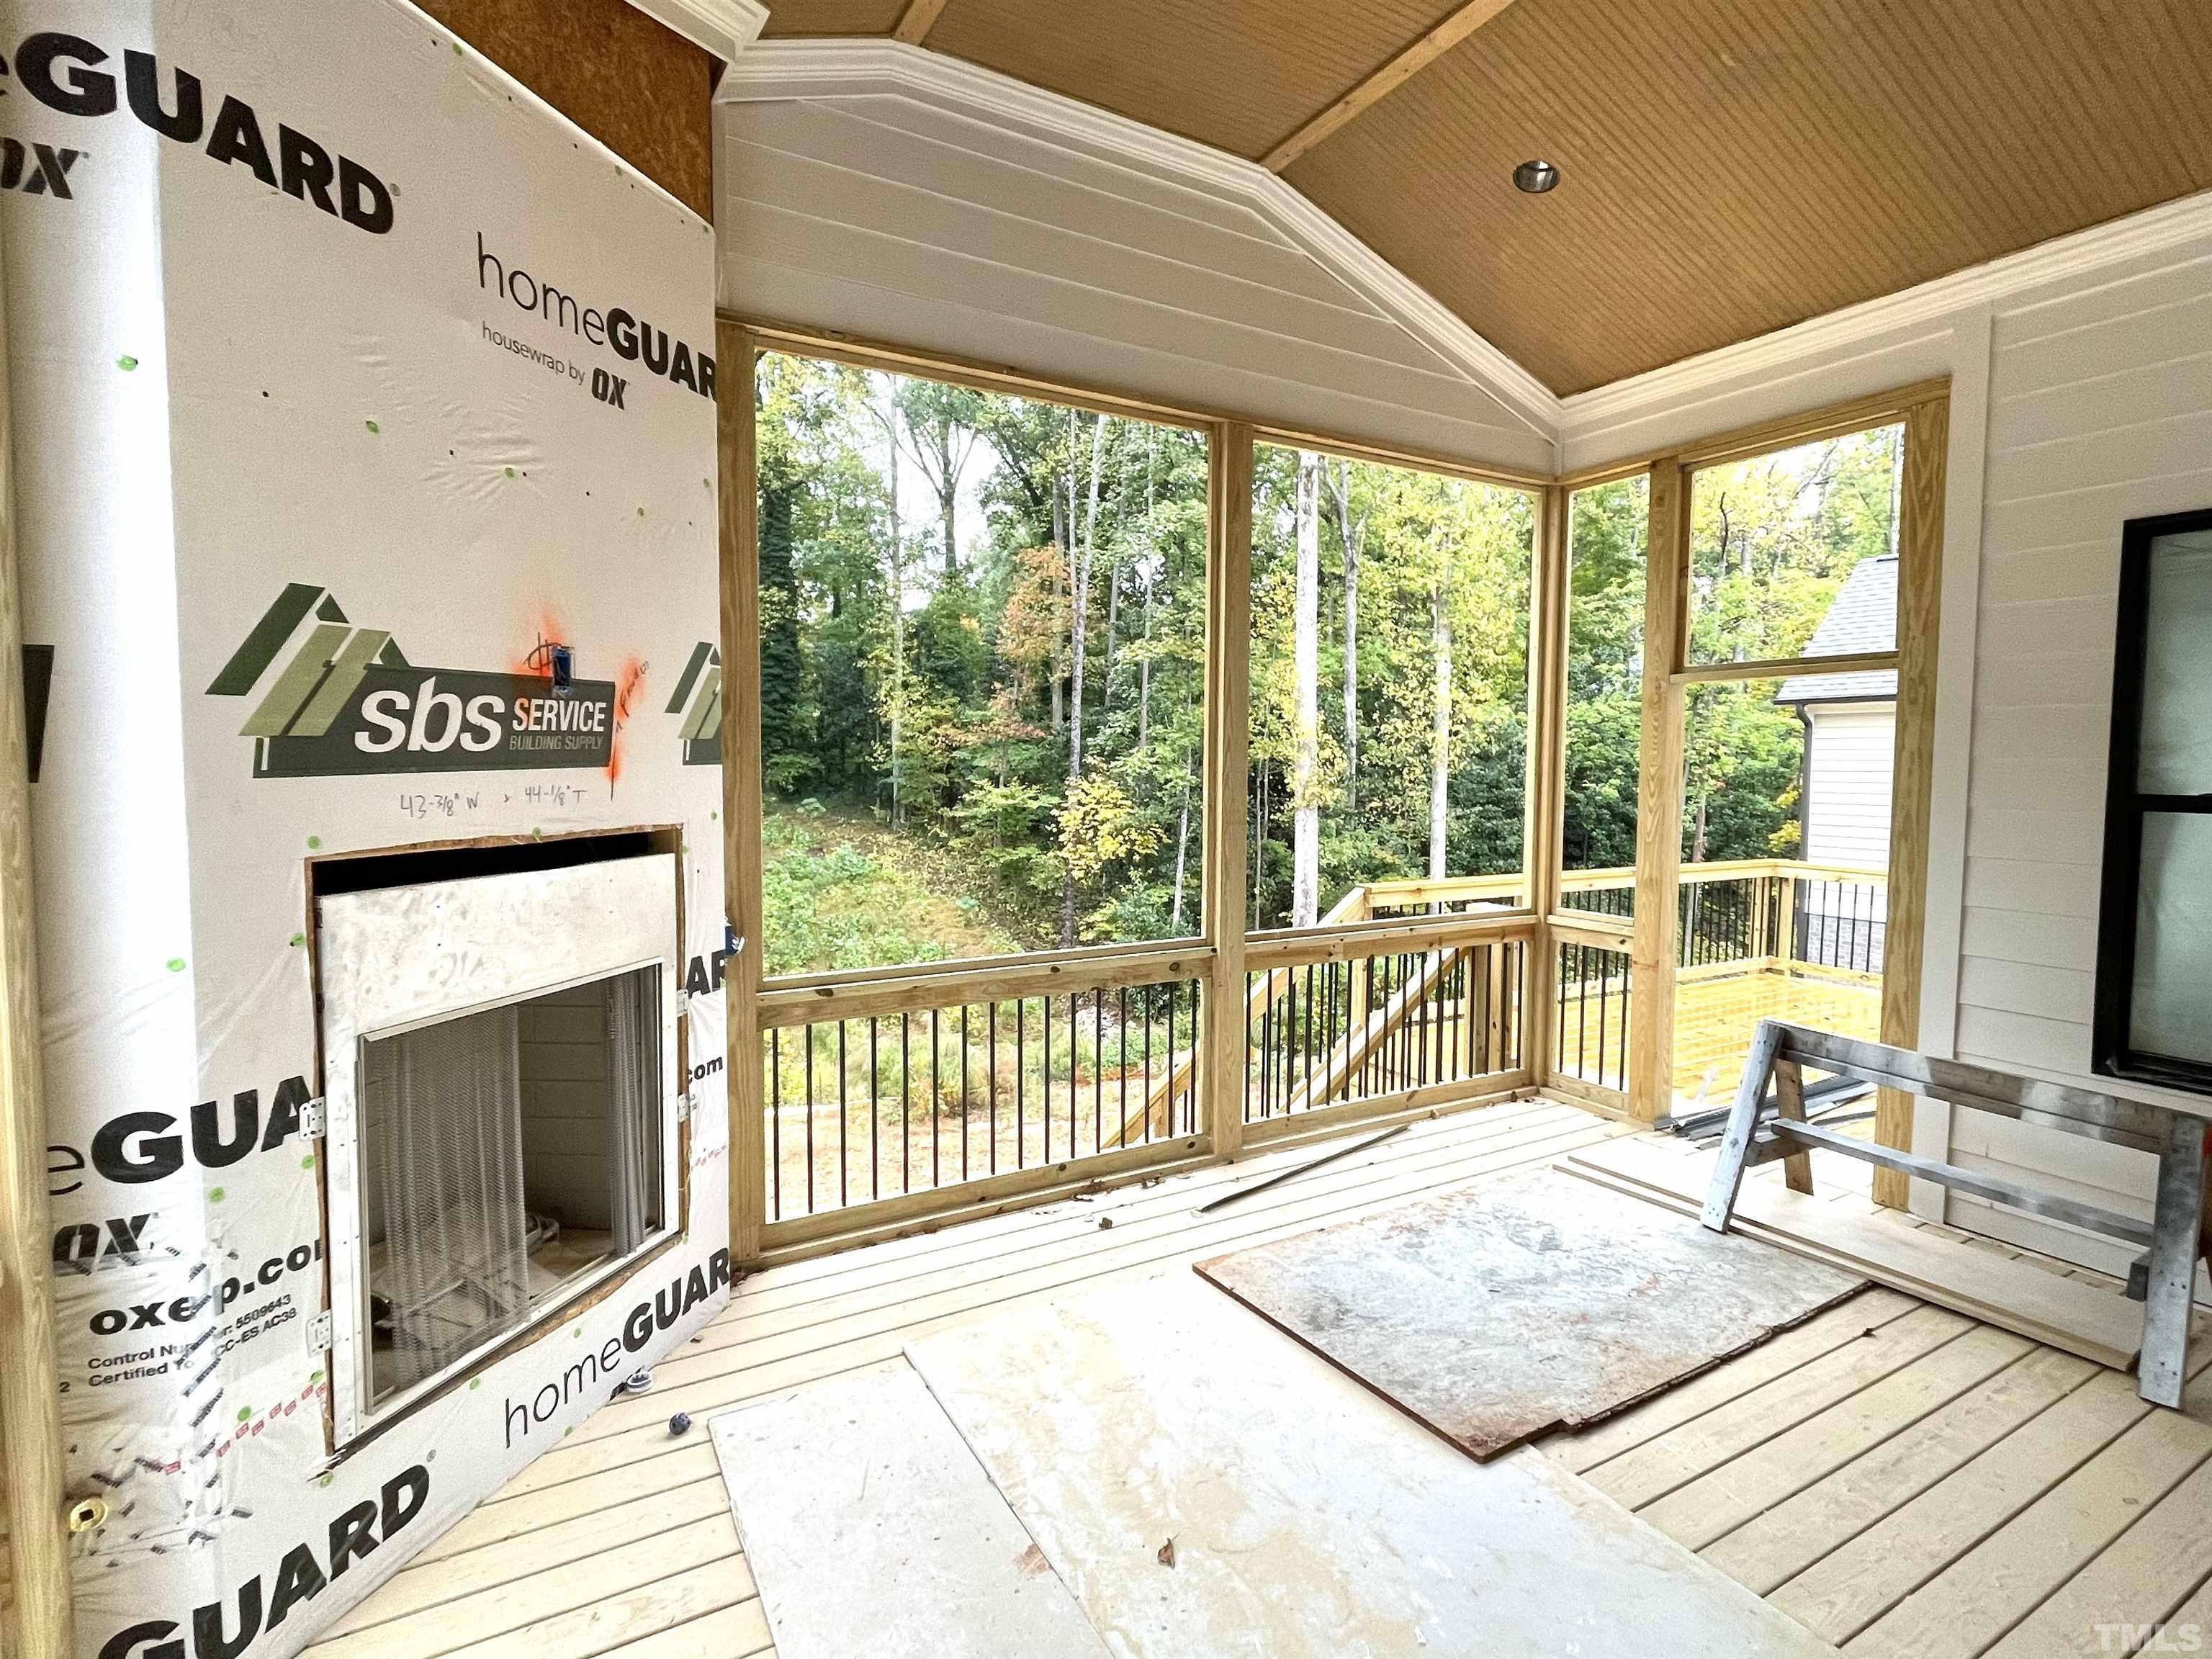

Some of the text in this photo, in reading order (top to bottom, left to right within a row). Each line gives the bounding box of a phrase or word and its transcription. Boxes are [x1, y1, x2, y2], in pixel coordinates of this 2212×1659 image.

[0, 32, 394, 235] GUARD
[482, 321, 626, 410] housewrap by OX
[354, 676, 607, 754] sbs SERVICE
[509, 734, 603, 750] BUILDING SUPPLY
[466, 791, 480, 809] W
[89, 1238, 323, 1336] oxep.co
[88, 1346, 156, 1370] Control
[235, 1293, 292, 1329] 5509643
[88, 1362, 168, 1387] Certified
[261, 1307, 297, 1333] AC38
